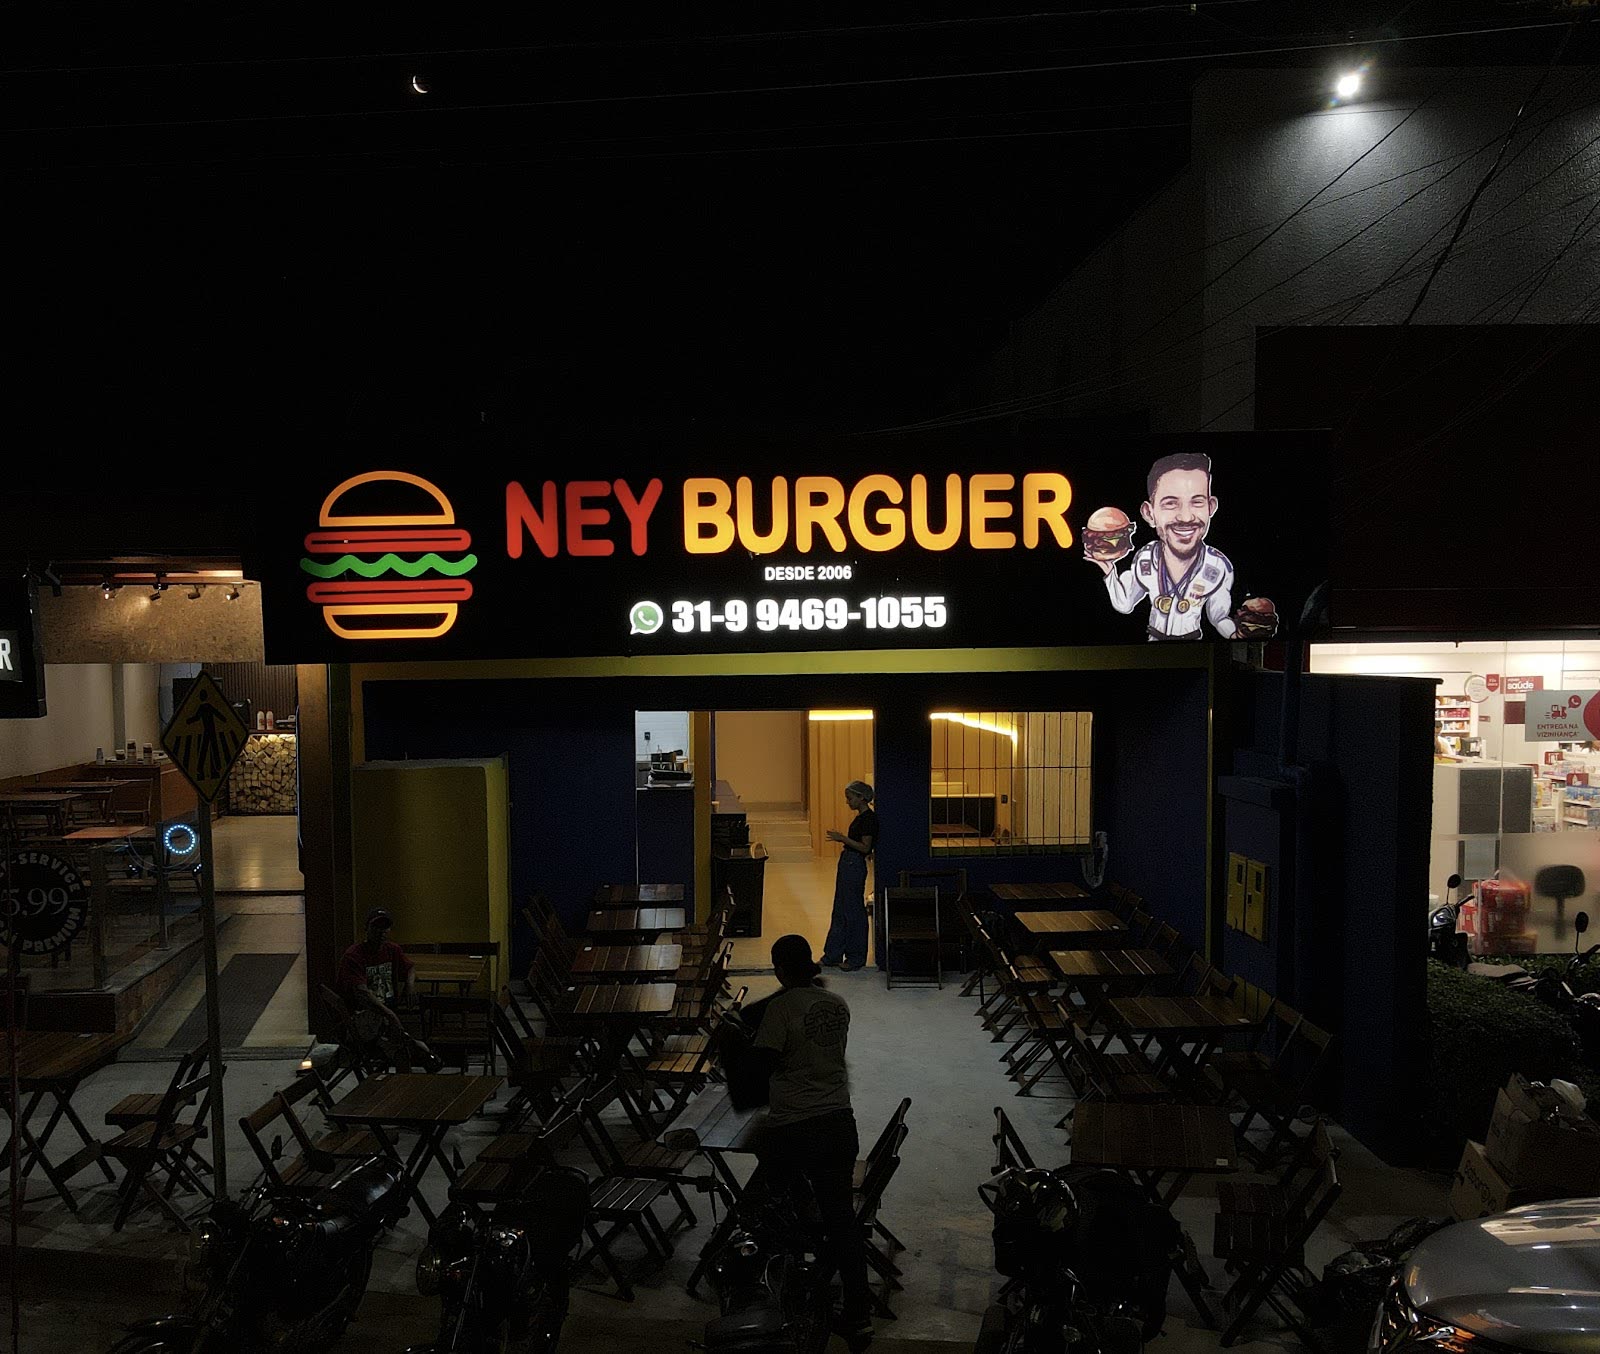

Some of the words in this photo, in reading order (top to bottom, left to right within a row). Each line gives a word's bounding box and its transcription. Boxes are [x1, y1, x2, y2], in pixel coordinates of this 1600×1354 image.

[506, 479, 663, 559] NEY
[683, 473, 1073, 555] BURGUER
[765, 566, 815, 581] DESDE
[817, 565, 852, 581] 2006
[672, 598, 748, 633] 31-9
[756, 596, 947, 632] 9469-1055
[22, 907, 81, 952] PREMIUM
